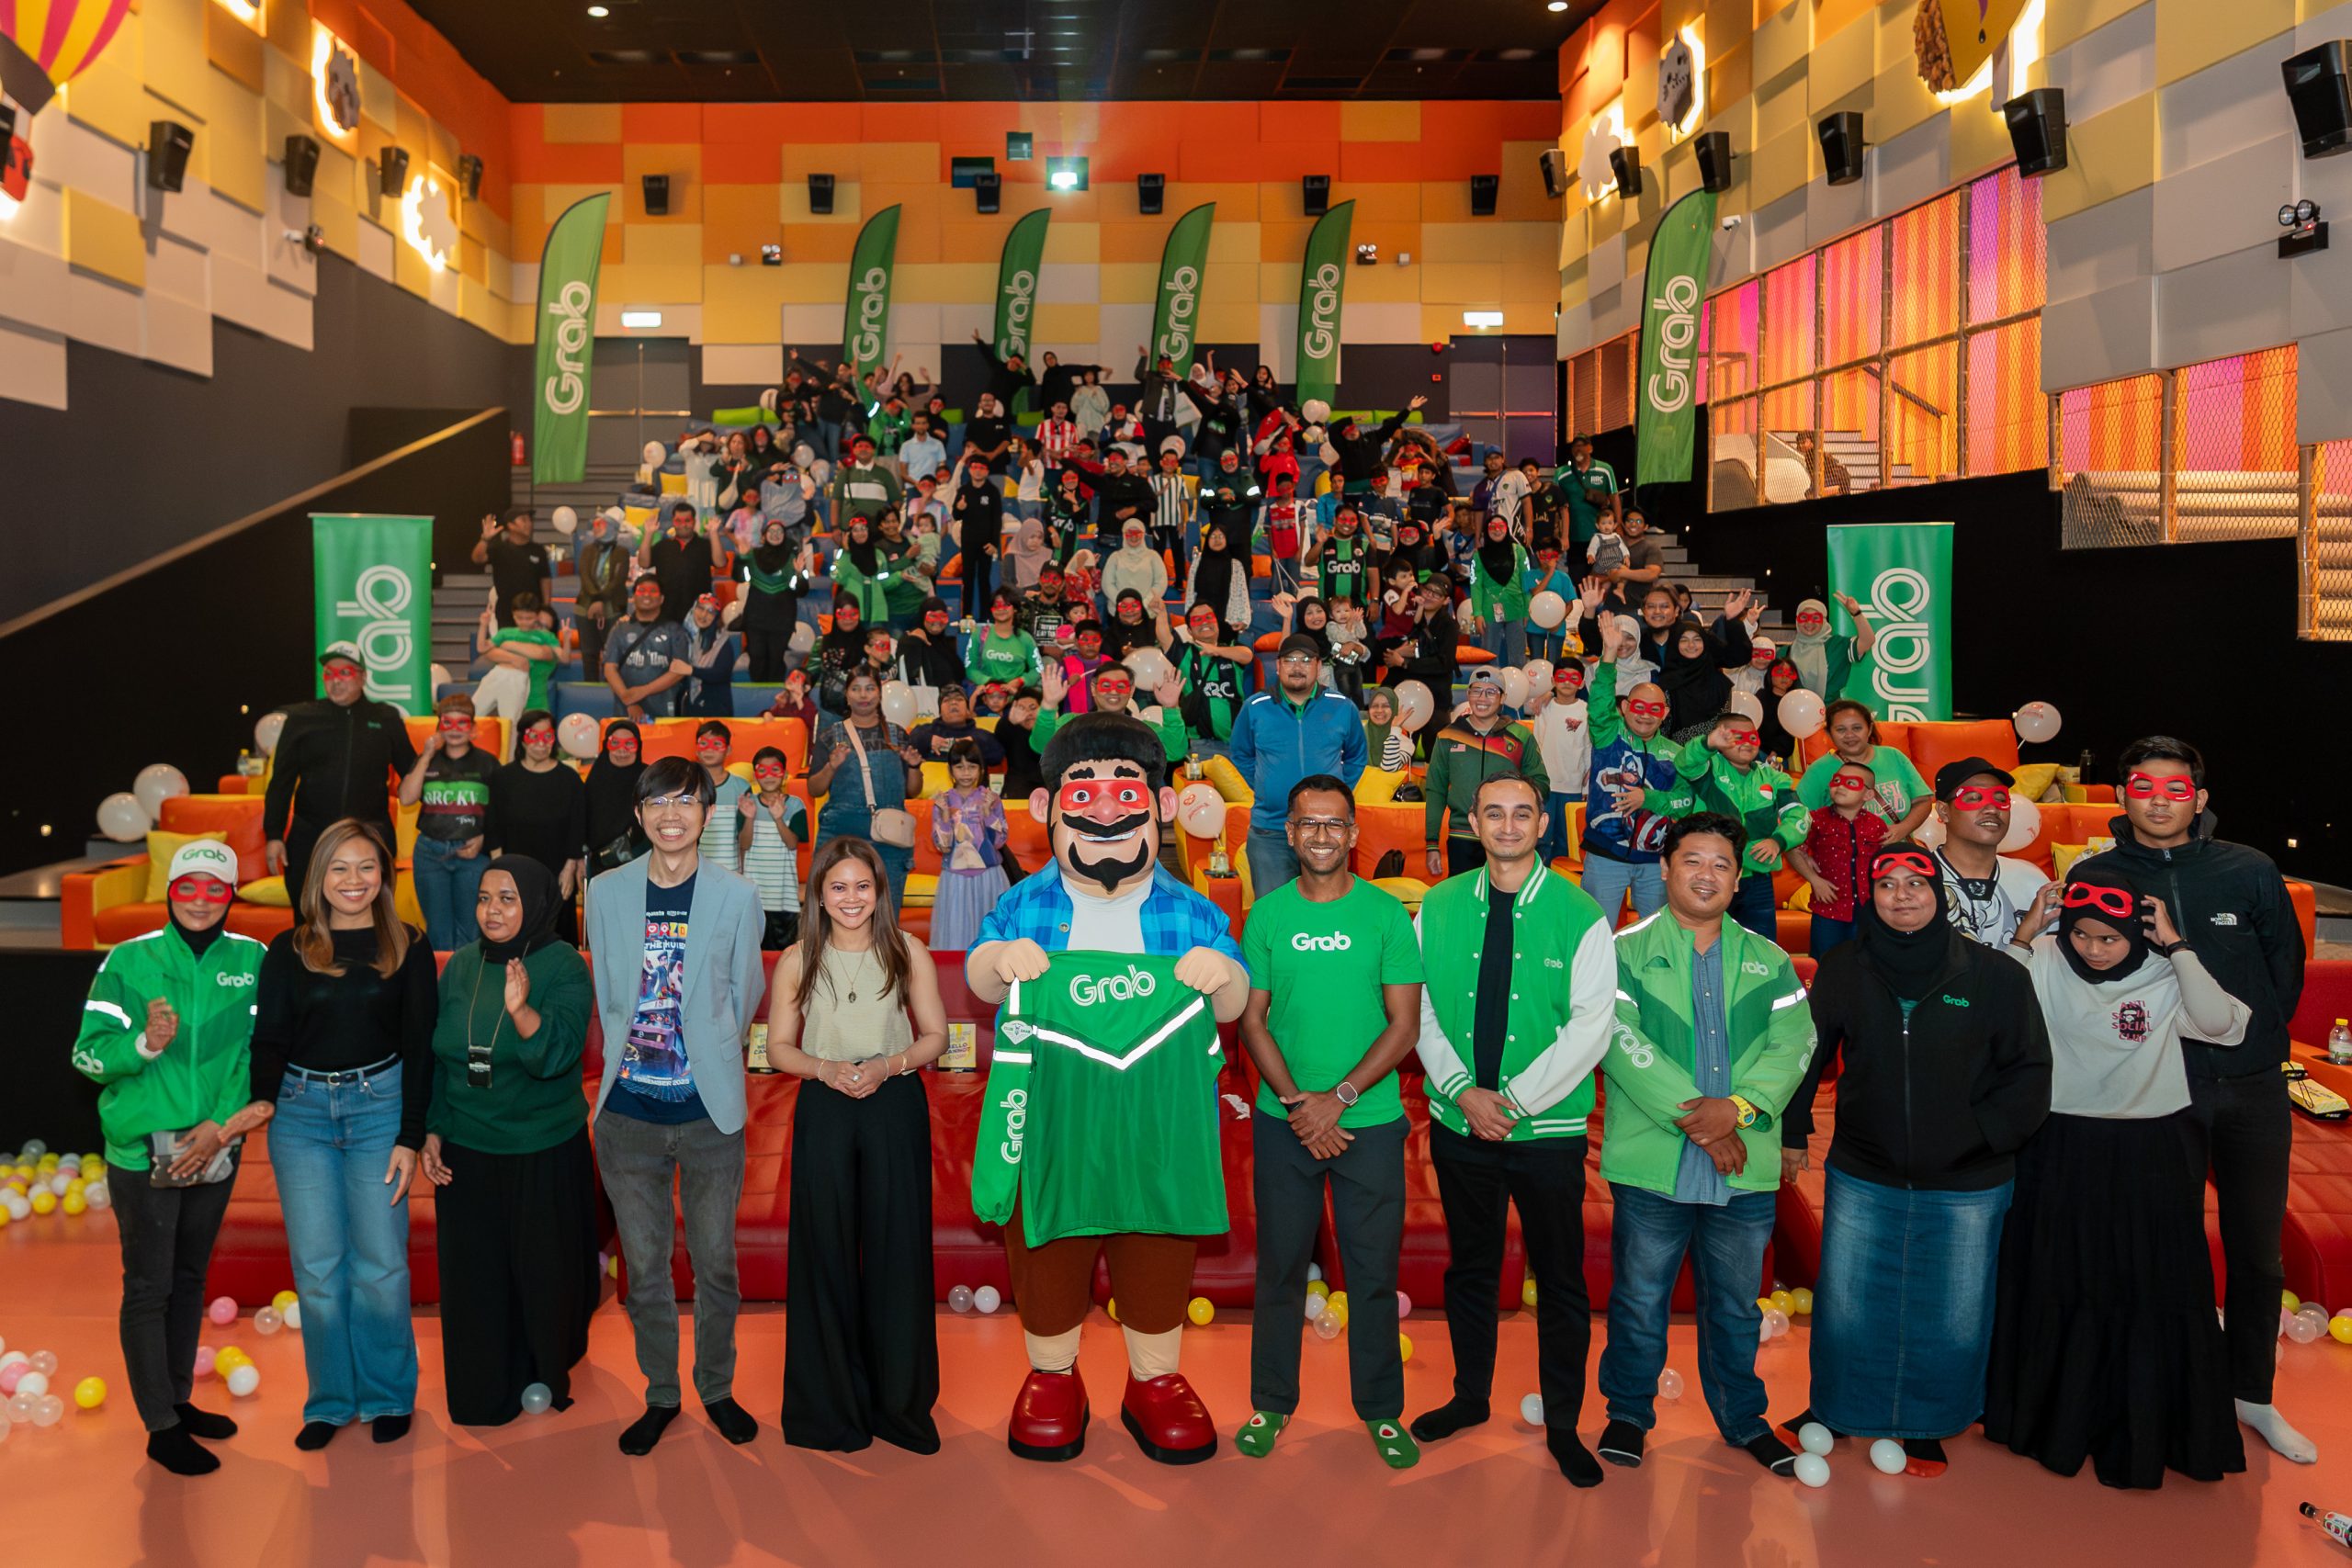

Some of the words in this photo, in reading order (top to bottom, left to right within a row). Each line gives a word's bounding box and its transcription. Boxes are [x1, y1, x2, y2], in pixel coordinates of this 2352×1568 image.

[854, 266, 887, 363] Grab
[1000, 270, 1035, 363] Grab
[1160, 265, 1198, 362] Grab
[1304, 263, 1340, 359] Grab
[545, 280, 592, 415] Grab
[1649, 274, 1698, 413] Grab
[1328, 560, 1361, 573] Grab
[336, 564, 413, 717] rab
[986, 649, 1013, 662] Grab
[182, 849, 227, 863] Grab
[1291, 931, 1351, 952] Grab
[217, 972, 254, 987] Grab
[1741, 962, 1770, 976] rab
[1069, 964, 1156, 1007] Grab
[1943, 995, 1970, 1008] Grab
[2111, 1010, 2152, 1021] SOIAL
[2120, 1000, 2146, 1010] ANTI
[2111, 1021, 2154, 1032] SOCIAL
[1612, 1017, 1655, 1069] rab
[1000, 1089, 1027, 1165] Grab
